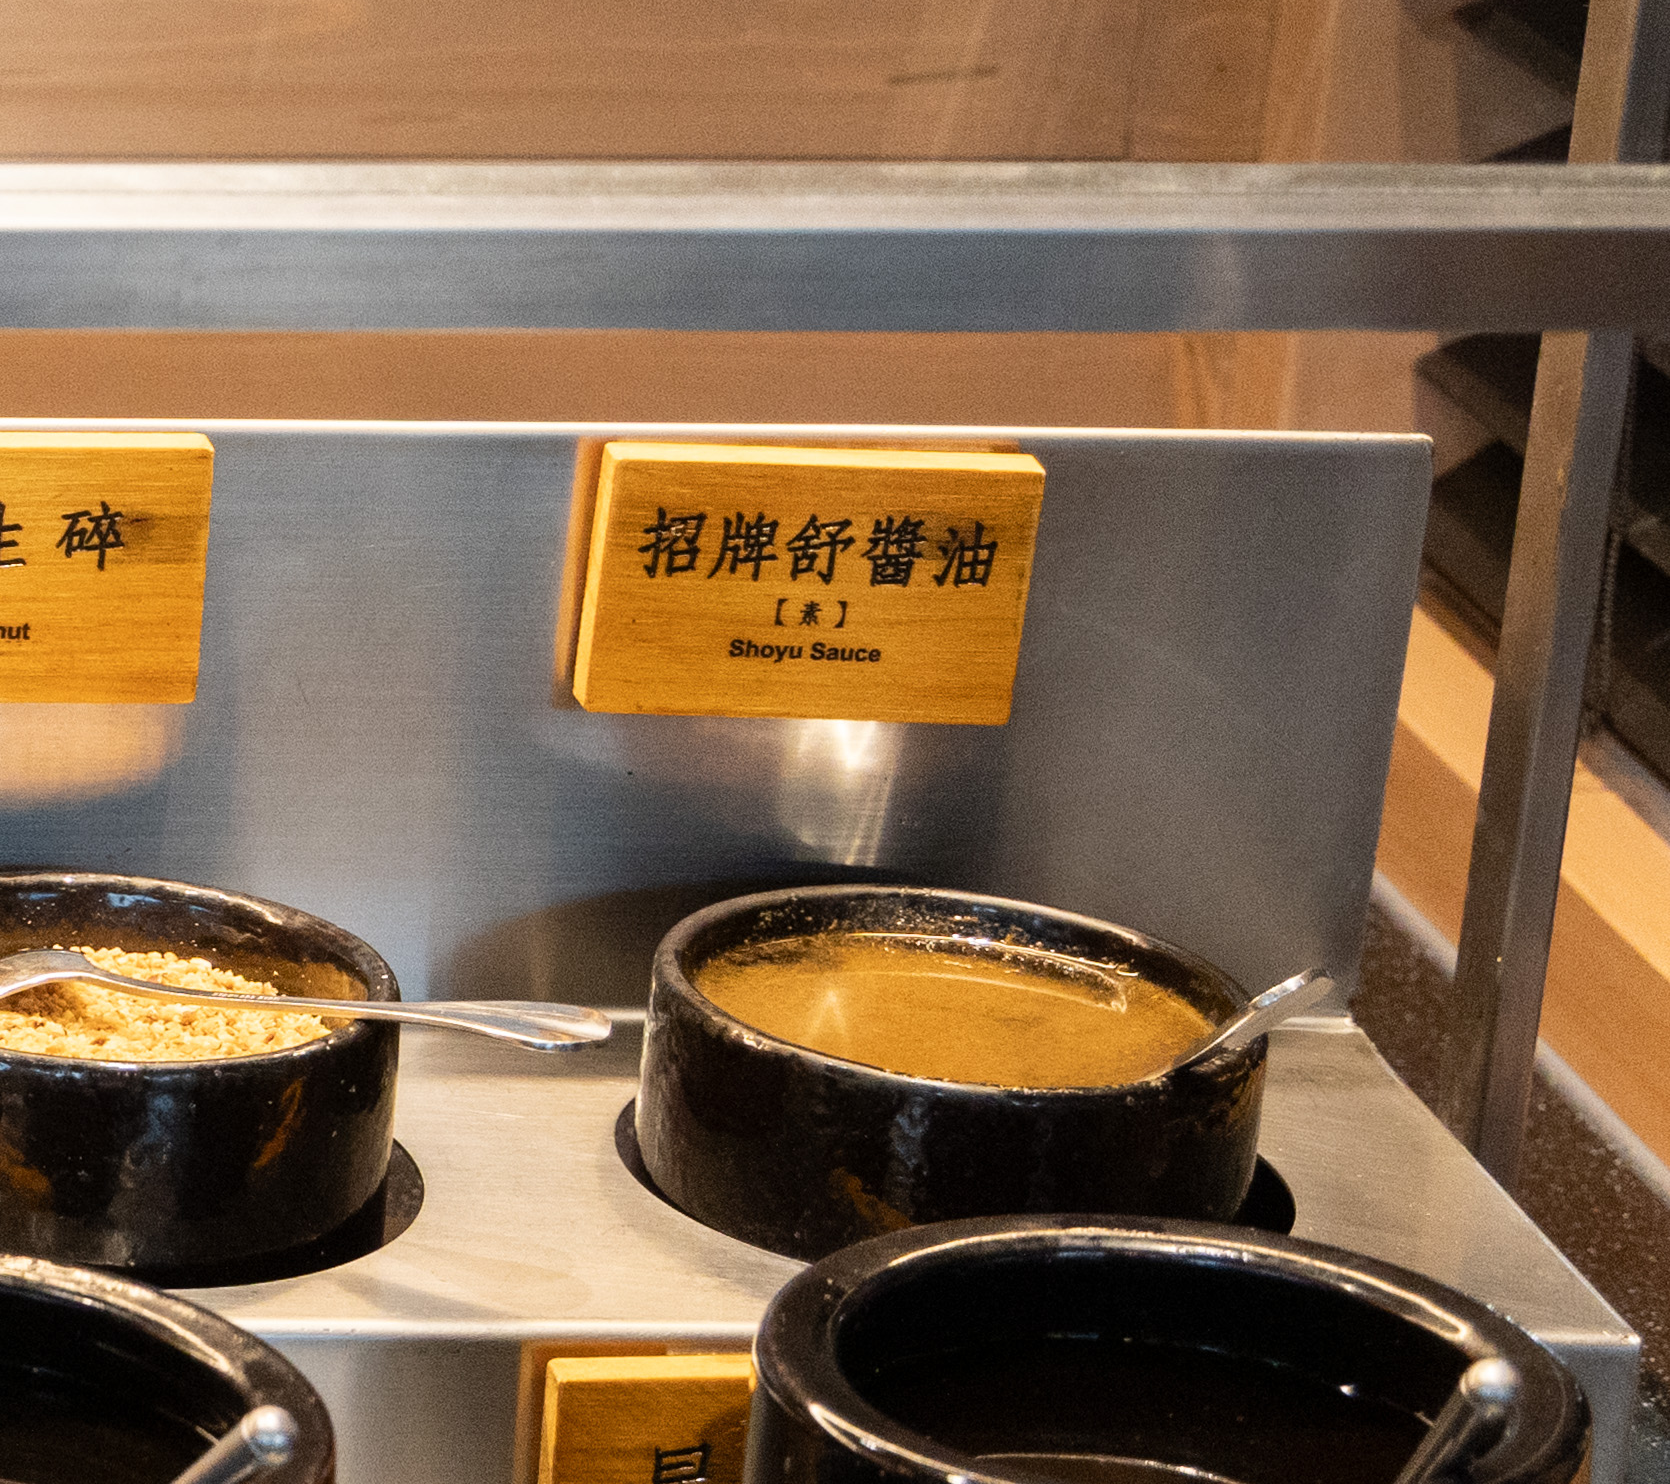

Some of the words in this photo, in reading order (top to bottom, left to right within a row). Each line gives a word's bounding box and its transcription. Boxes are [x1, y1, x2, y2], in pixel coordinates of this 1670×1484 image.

[637, 506, 999, 588] 招牌舒醬油
[728, 636, 802, 665] Shoyu
[810, 640, 881, 664] Sauce
